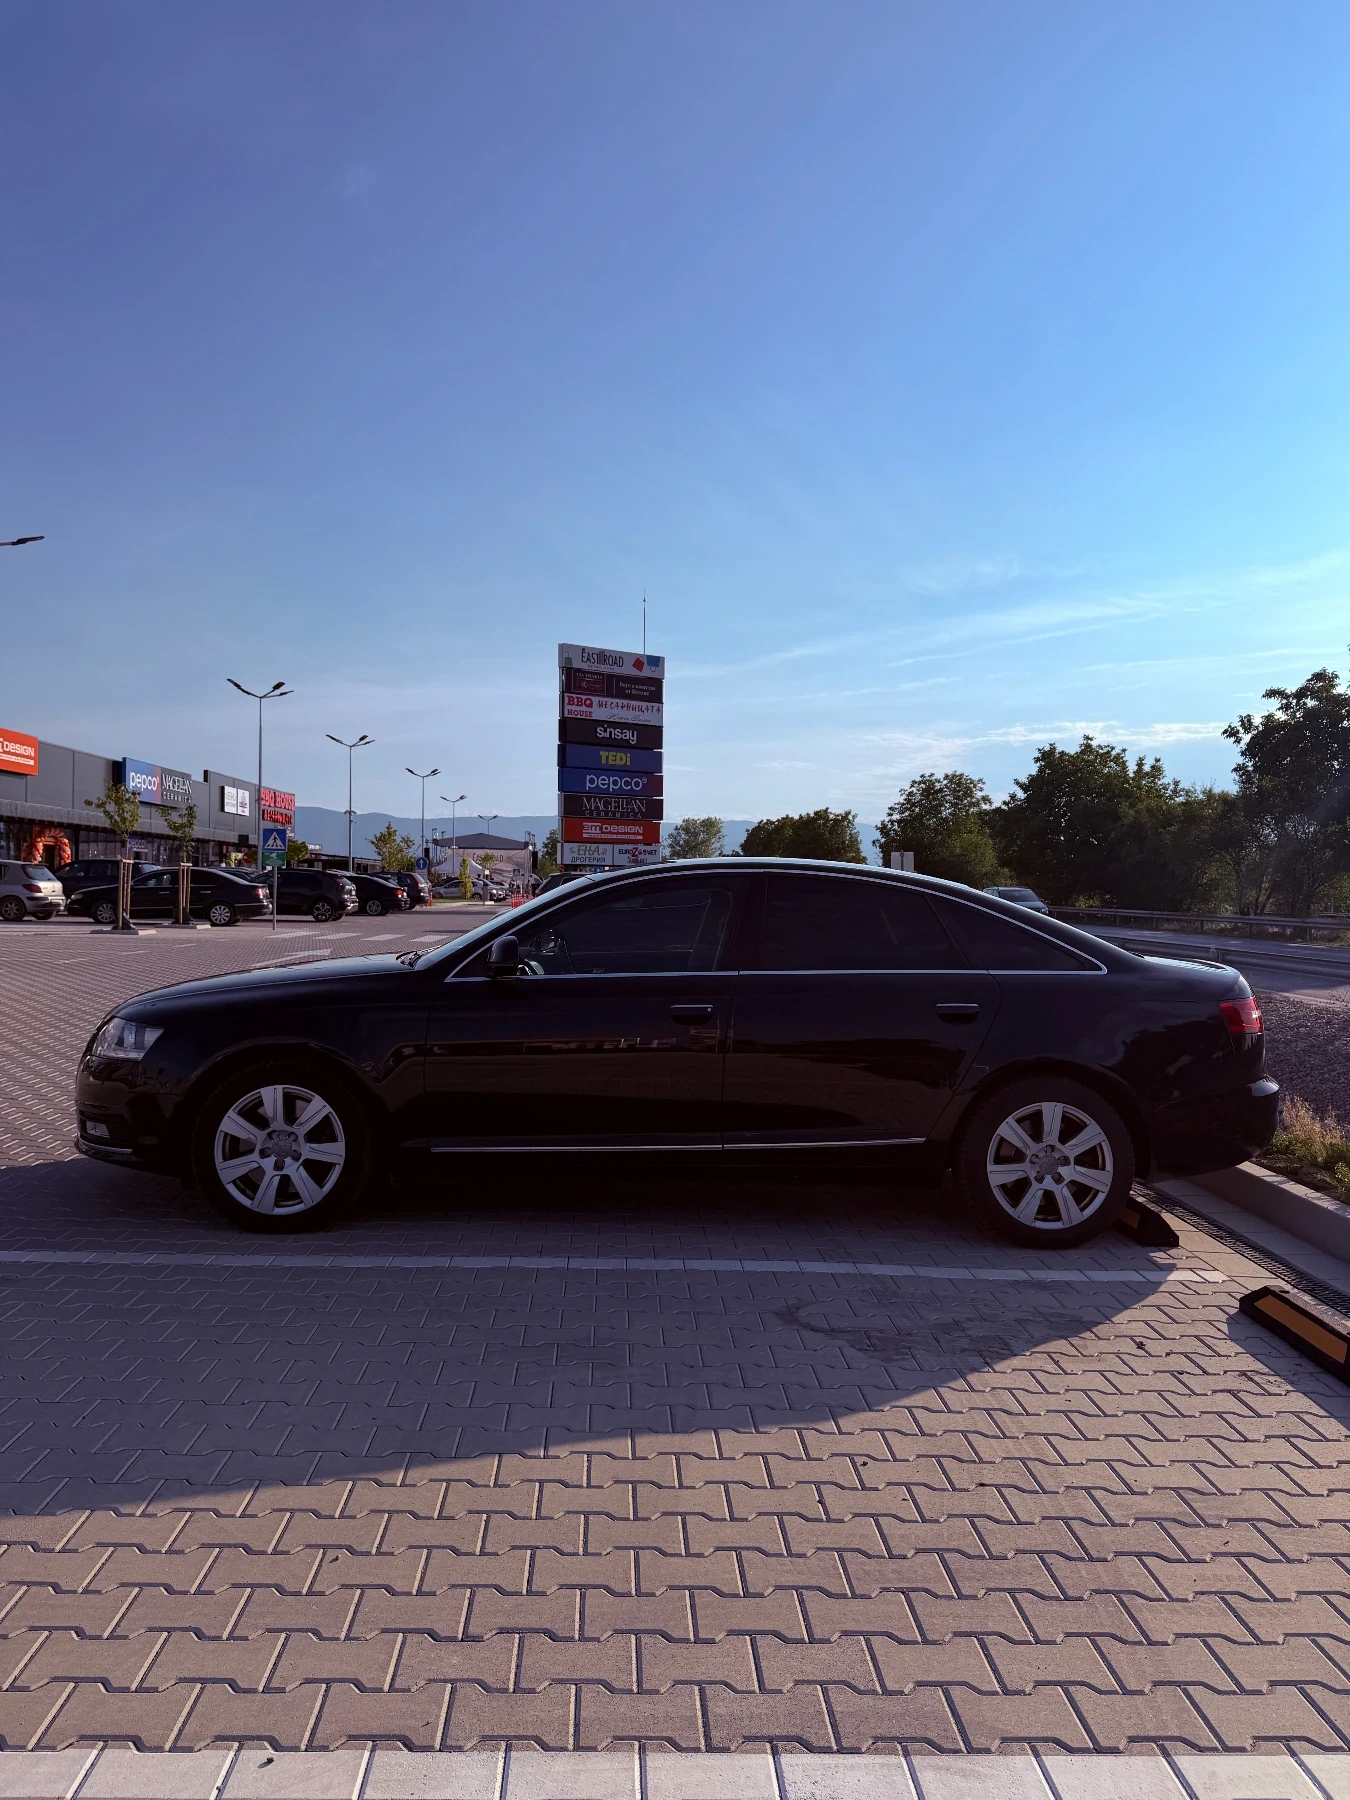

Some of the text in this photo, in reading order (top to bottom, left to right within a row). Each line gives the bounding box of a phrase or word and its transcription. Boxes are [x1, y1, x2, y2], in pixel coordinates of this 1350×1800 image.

[566, 695, 593, 709] BBQ
[597, 700, 661, 714] МЕСАРНИЦАТА
[566, 709, 593, 718] HOUSE
[596, 724, 637, 744] sinsay
[600, 751, 631, 766] TEDi
[275, 791, 296, 811] HOUSE
[582, 797, 646, 813] MAGELLAN
[570, 856, 606, 864] ДРОГЕРИЯ
